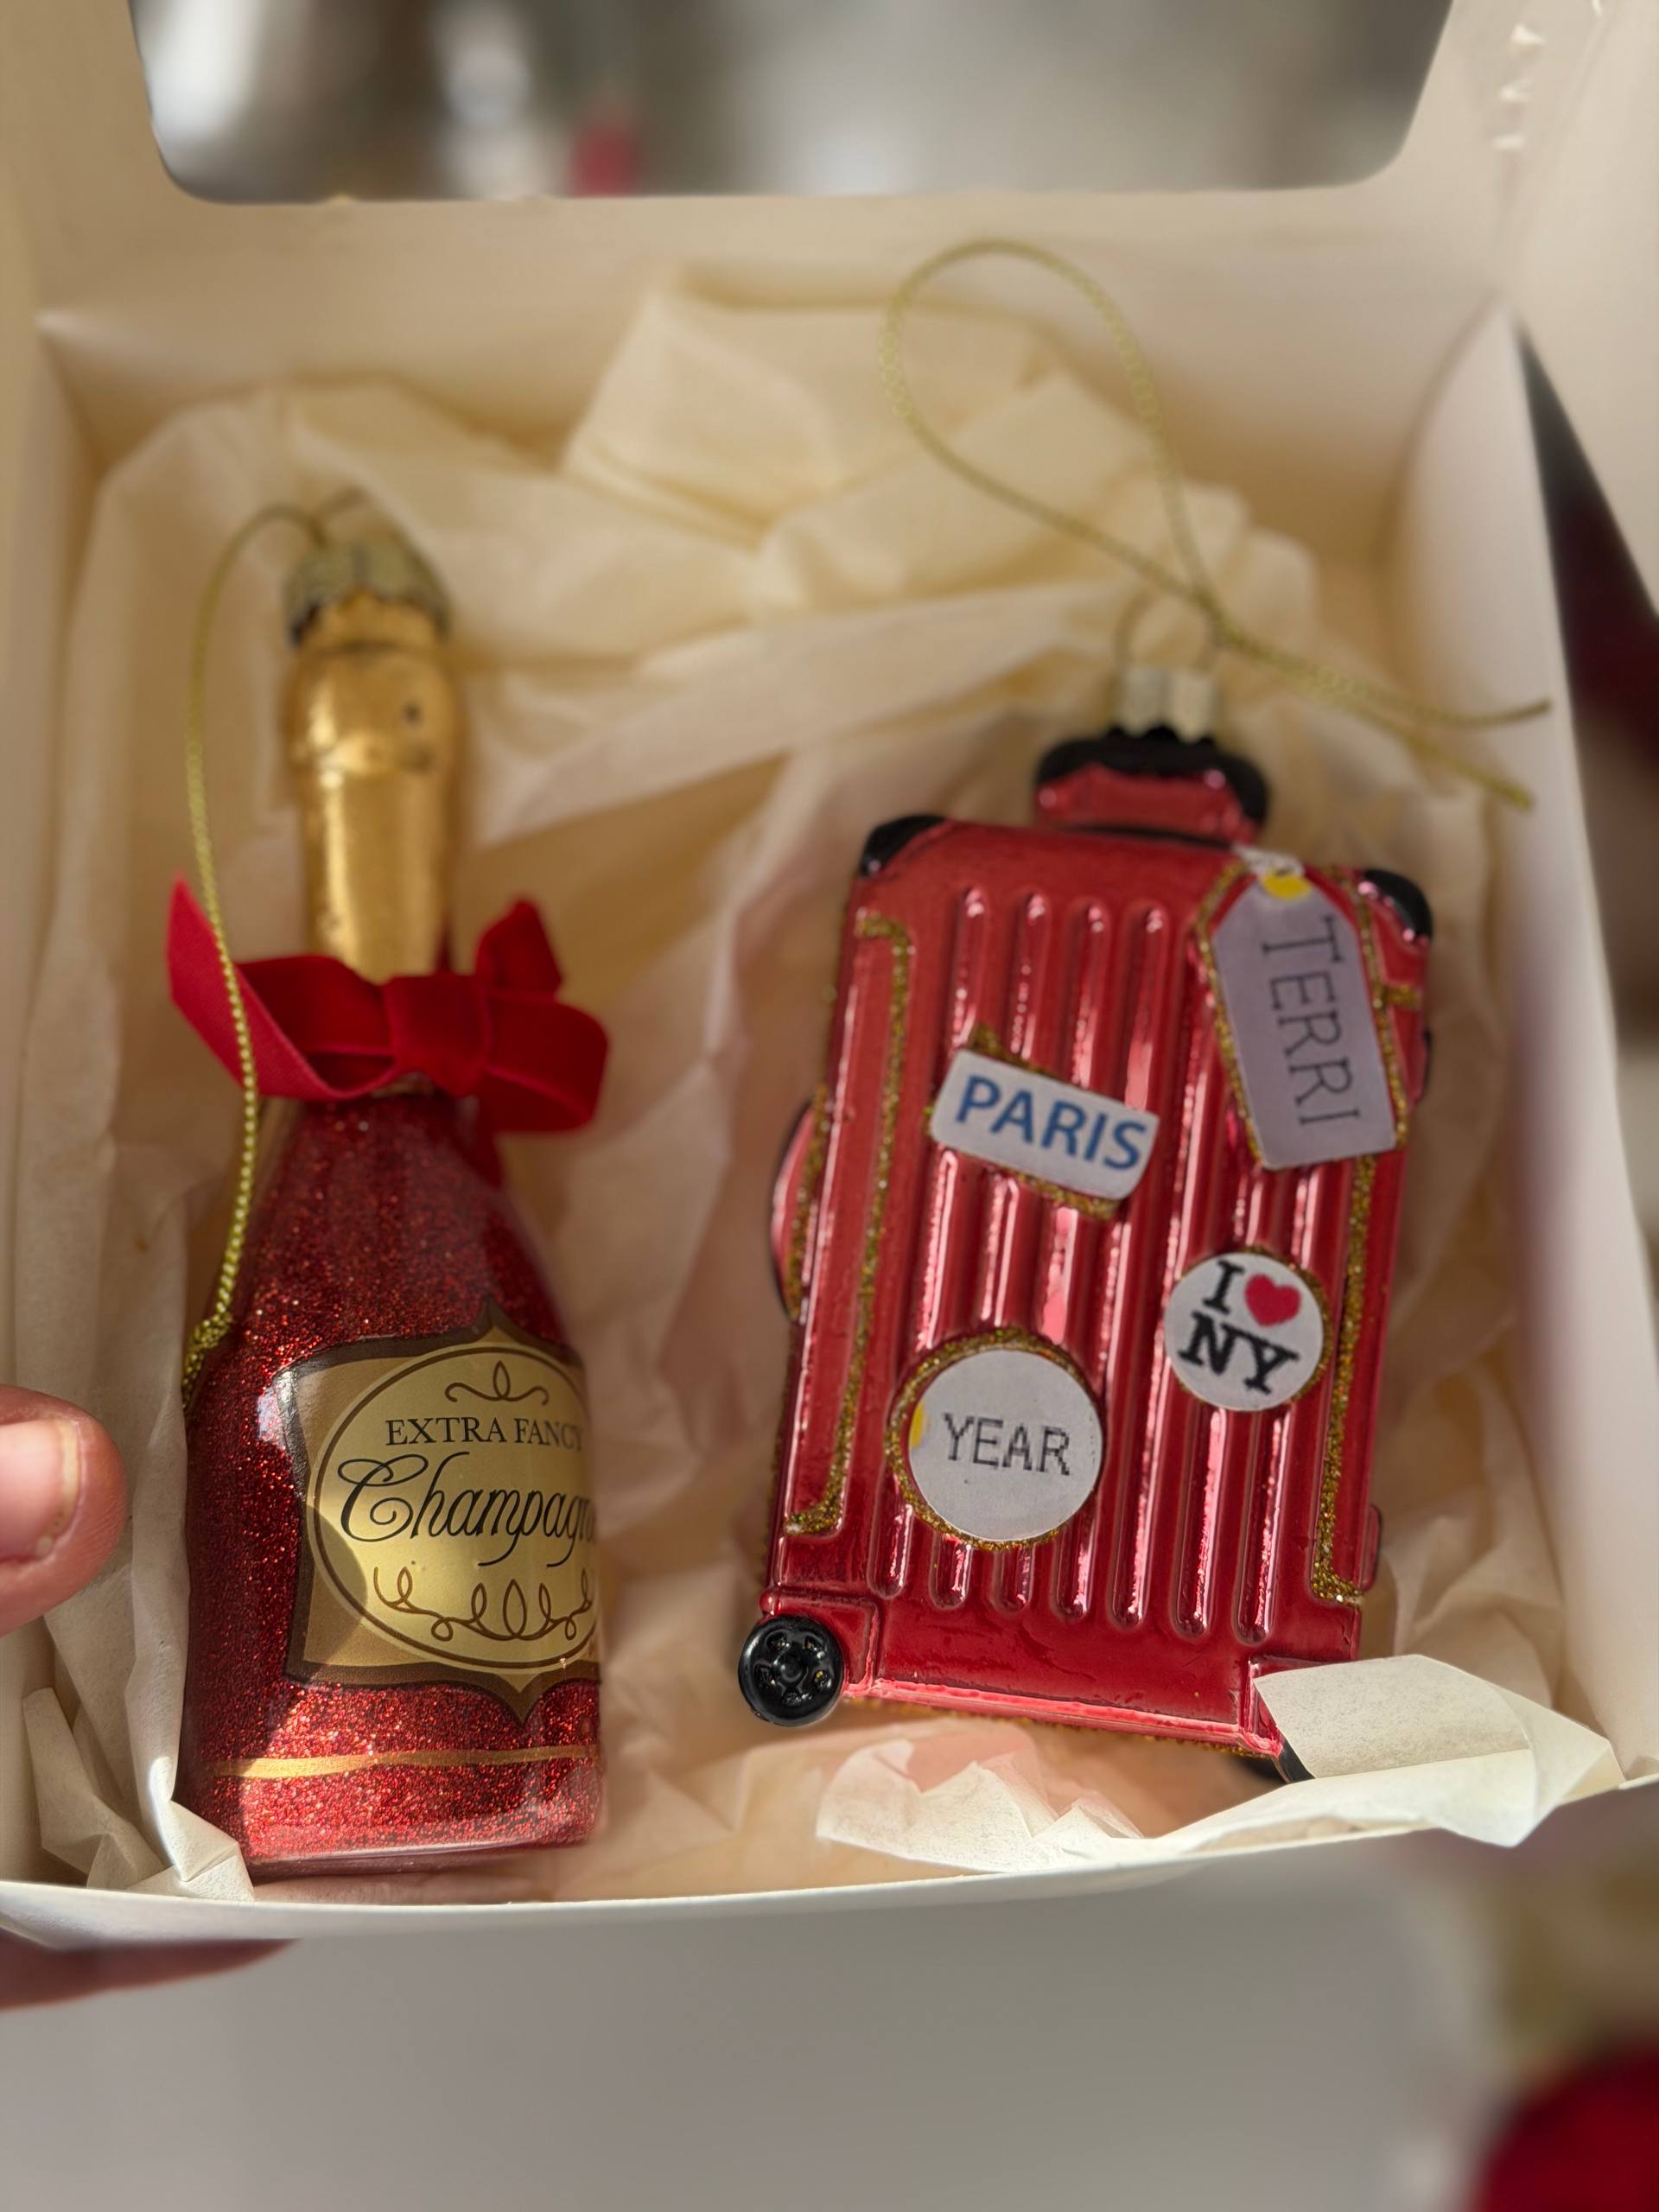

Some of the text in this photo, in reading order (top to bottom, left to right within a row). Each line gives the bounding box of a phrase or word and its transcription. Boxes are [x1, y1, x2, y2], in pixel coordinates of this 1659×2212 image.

[1261, 914, 1361, 1125] TERRI
[956, 1074, 1147, 1171] PARIS
[1202, 1259, 1245, 1315] I
[1178, 1310, 1300, 1395] NY
[385, 1417, 507, 1446] EXTRA
[944, 1411, 1070, 1476] YEAR
